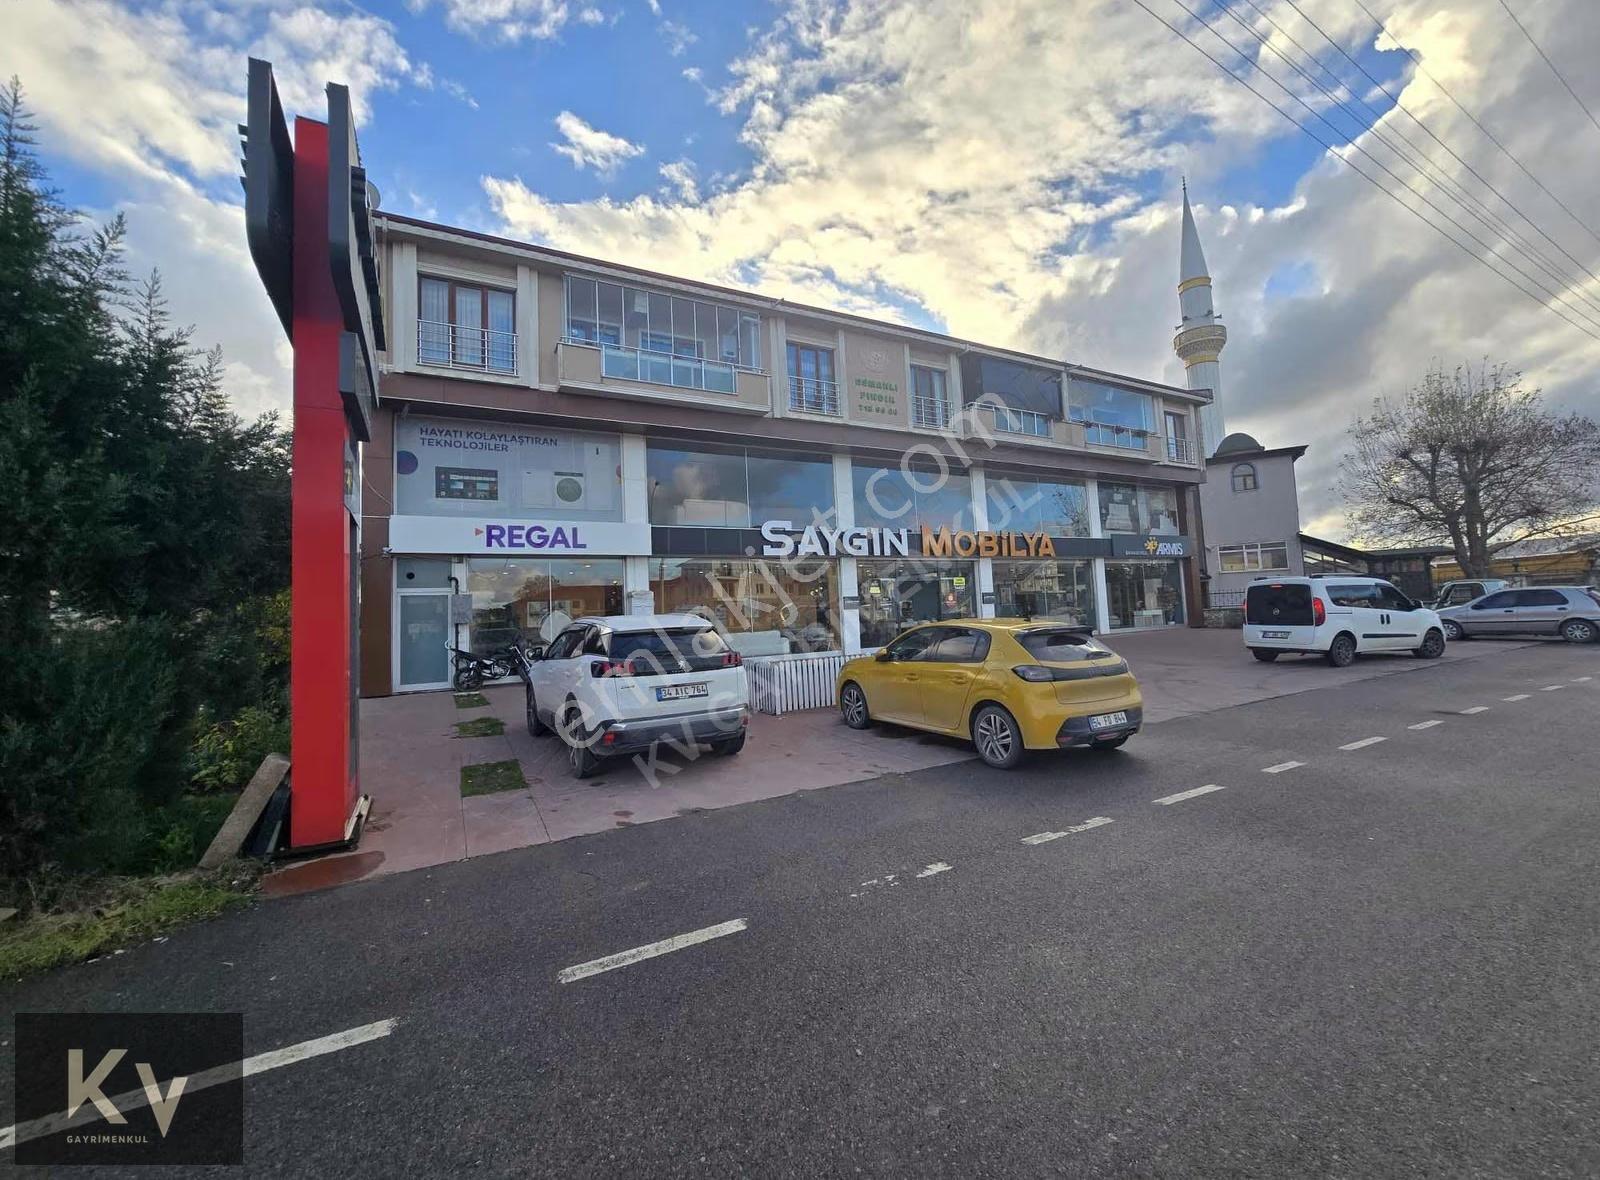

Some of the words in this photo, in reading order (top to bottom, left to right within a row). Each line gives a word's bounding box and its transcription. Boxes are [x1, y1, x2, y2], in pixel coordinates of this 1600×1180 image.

[420, 427, 463, 438] HAYATI
[466, 431, 558, 447] KOLAYLAŞTIRAN
[485, 524, 587, 549] REGAL
[761, 520, 909, 556] SAYGIN
[662, 688, 672, 697] 34
